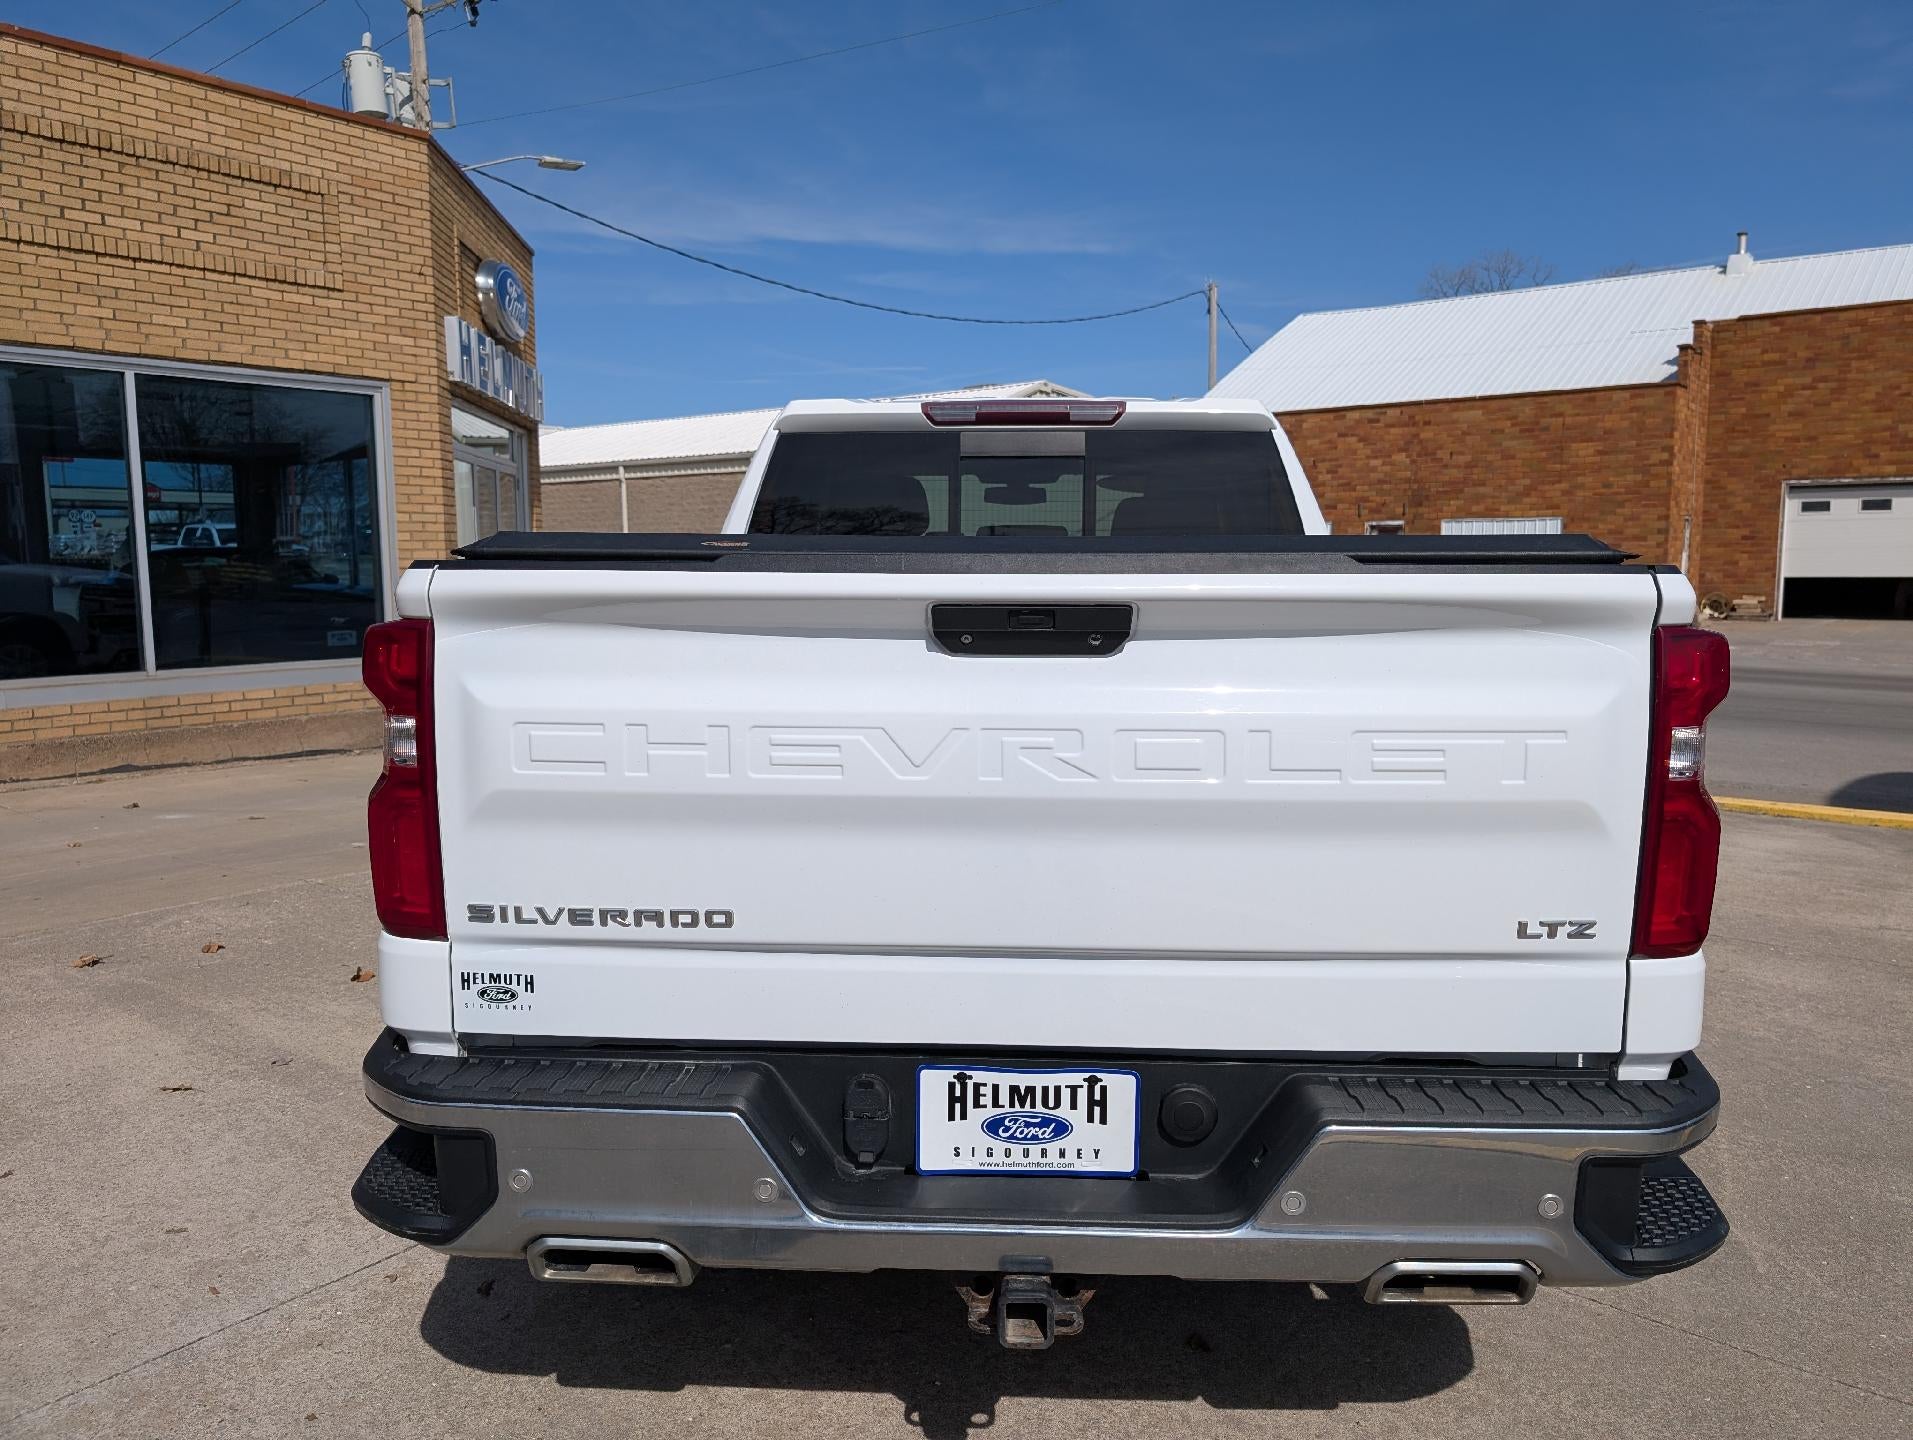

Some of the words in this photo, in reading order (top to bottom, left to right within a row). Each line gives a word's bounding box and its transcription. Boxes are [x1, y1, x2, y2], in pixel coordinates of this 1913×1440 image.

[512, 721, 1568, 784] CHEVROLET
[466, 903, 735, 929] SILVERADO
[1516, 920, 1598, 940] LTZ
[460, 971, 535, 994] HELMUTH
[947, 1079, 1108, 1126] HELMUTH
[998, 1115, 1055, 1140] Ford
[953, 1146, 1101, 1160] SIGOURNEY
[978, 1160, 1076, 1169] www.helmuthford.com
